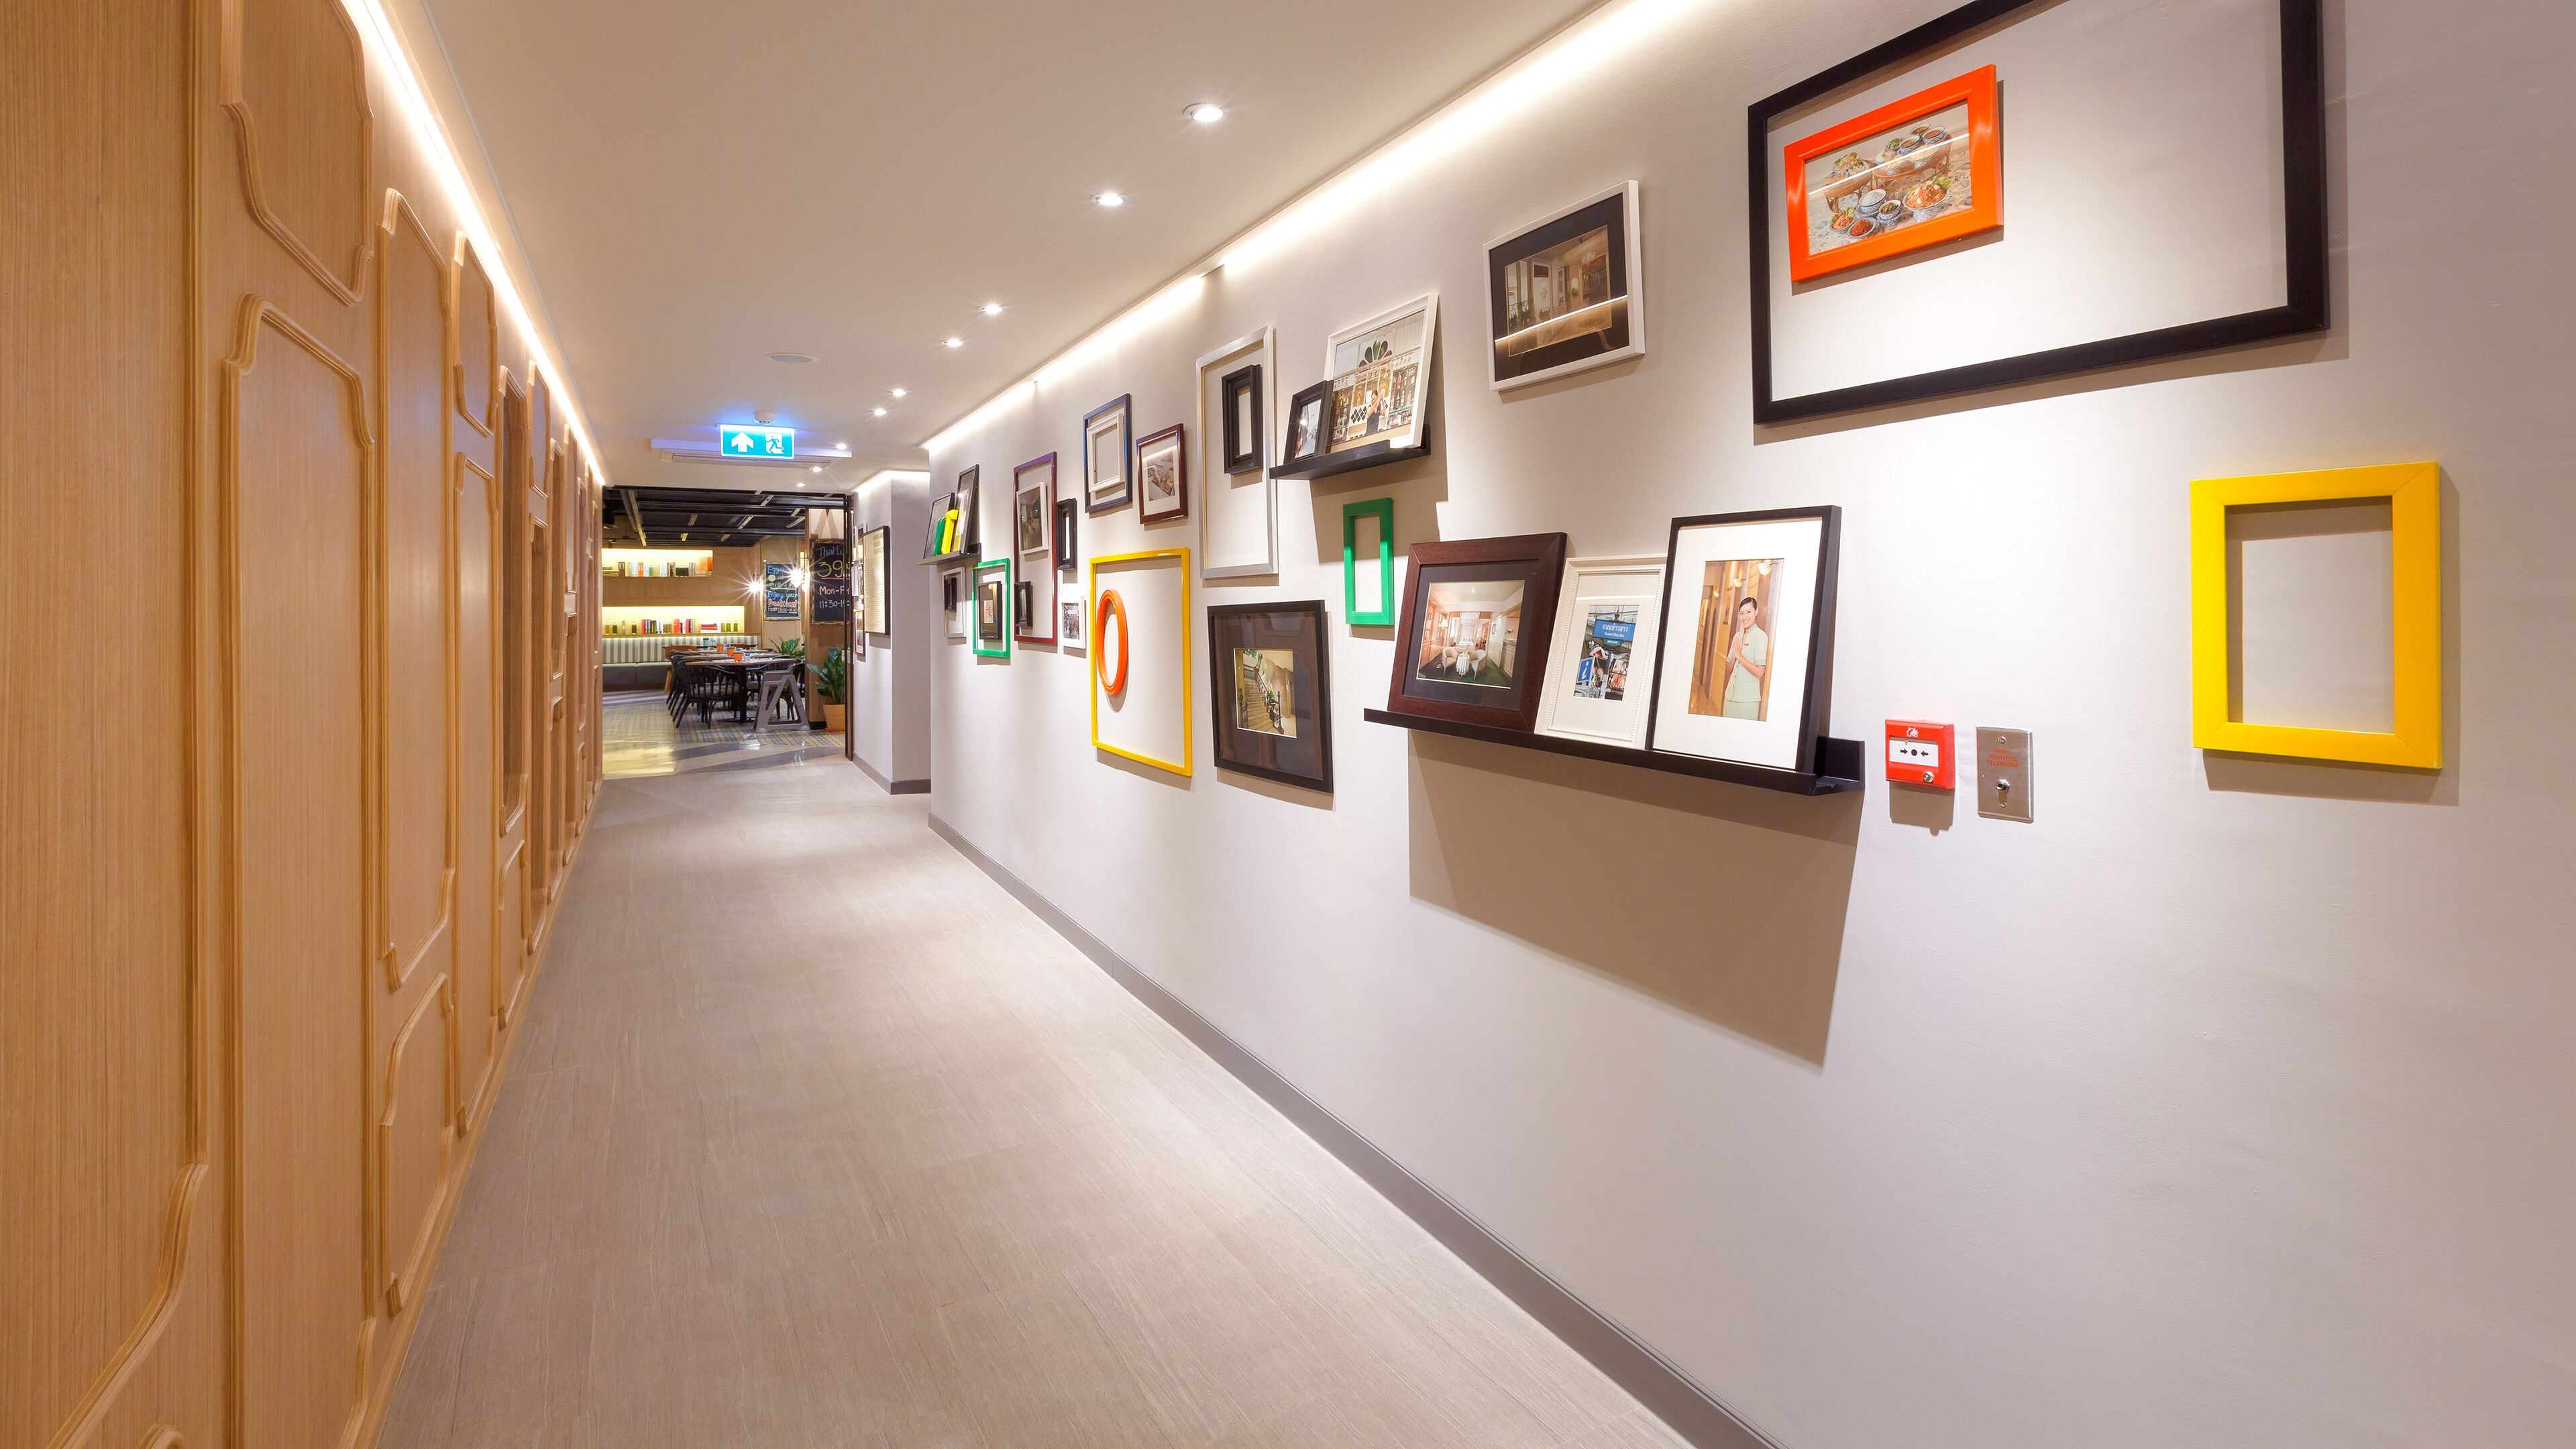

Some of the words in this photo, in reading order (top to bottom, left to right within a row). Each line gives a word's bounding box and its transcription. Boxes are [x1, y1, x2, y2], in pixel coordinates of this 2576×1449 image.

[816, 546, 835, 557] Thai
[767, 590, 784, 601] Enjoy
[786, 593, 798, 602] your
